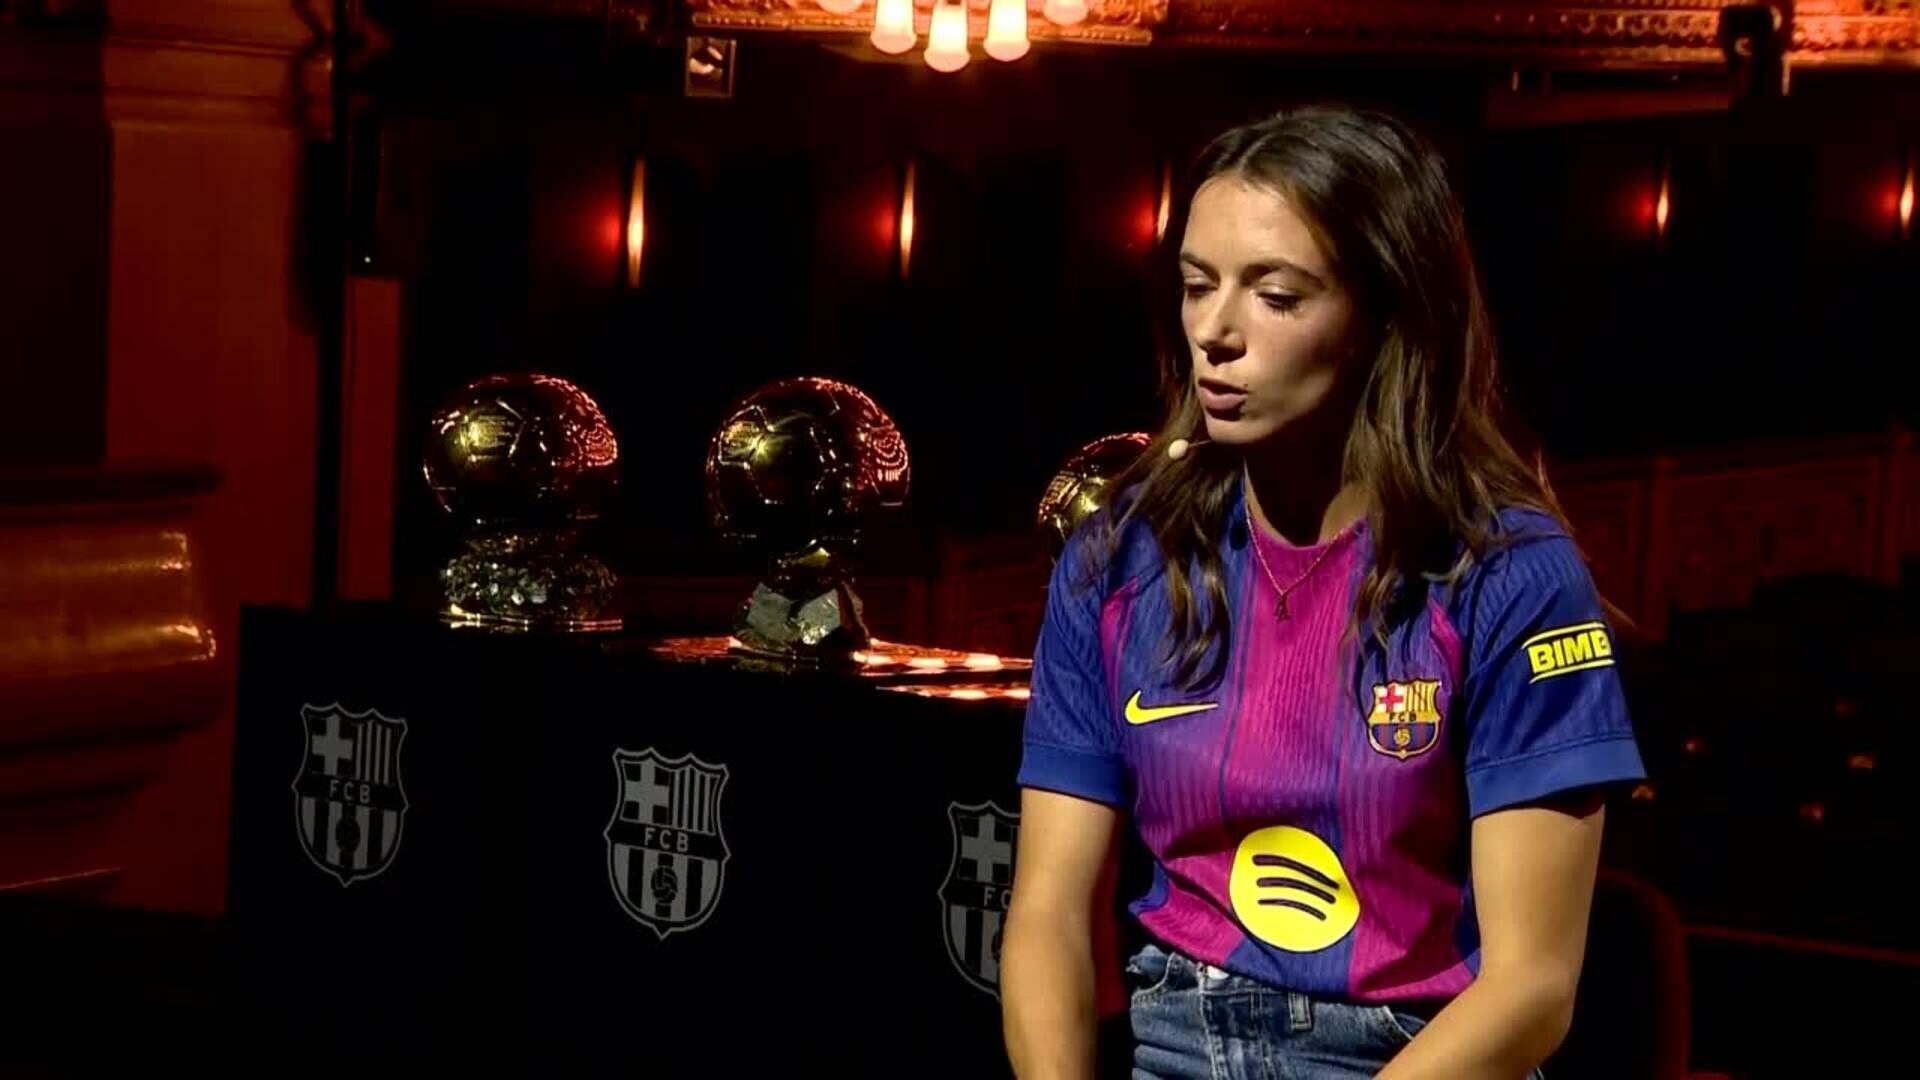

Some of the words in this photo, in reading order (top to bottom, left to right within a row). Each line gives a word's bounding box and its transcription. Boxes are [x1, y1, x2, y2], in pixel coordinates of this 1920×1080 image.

[1527, 628, 1612, 675] BIMB
[1389, 711, 1417, 722] FCB
[329, 779, 371, 805] FCB
[643, 826, 689, 852] FCB
[983, 886, 1010, 911] FC
